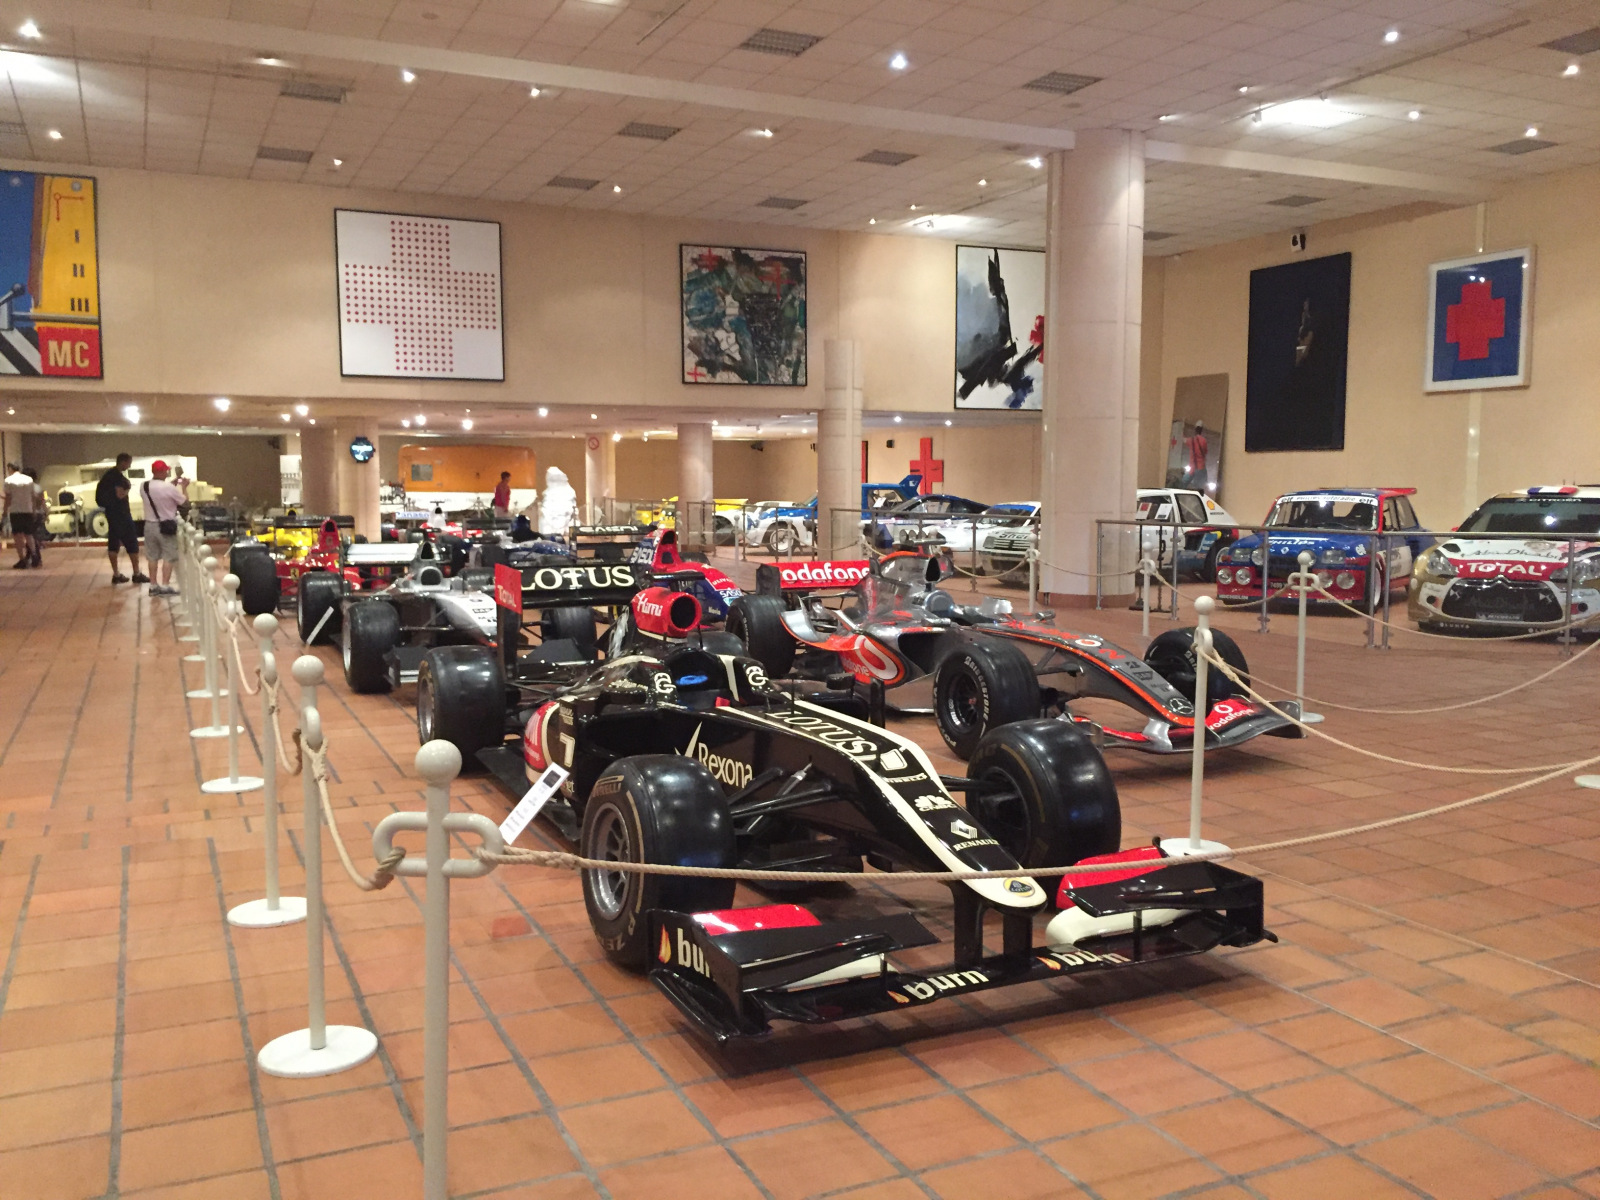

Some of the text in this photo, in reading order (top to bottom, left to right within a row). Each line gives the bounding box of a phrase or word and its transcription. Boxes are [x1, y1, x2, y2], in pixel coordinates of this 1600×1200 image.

[48, 340, 90, 368] MC
[1466, 561, 1542, 576] TOTAL
[766, 710, 878, 758] LOTUS
[1208, 707, 1255, 731] vodafone
[559, 732, 576, 768] 7
[698, 742, 754, 789] Rexona
[952, 838, 1001, 852] RENAULT
[903, 968, 990, 1000] burn
